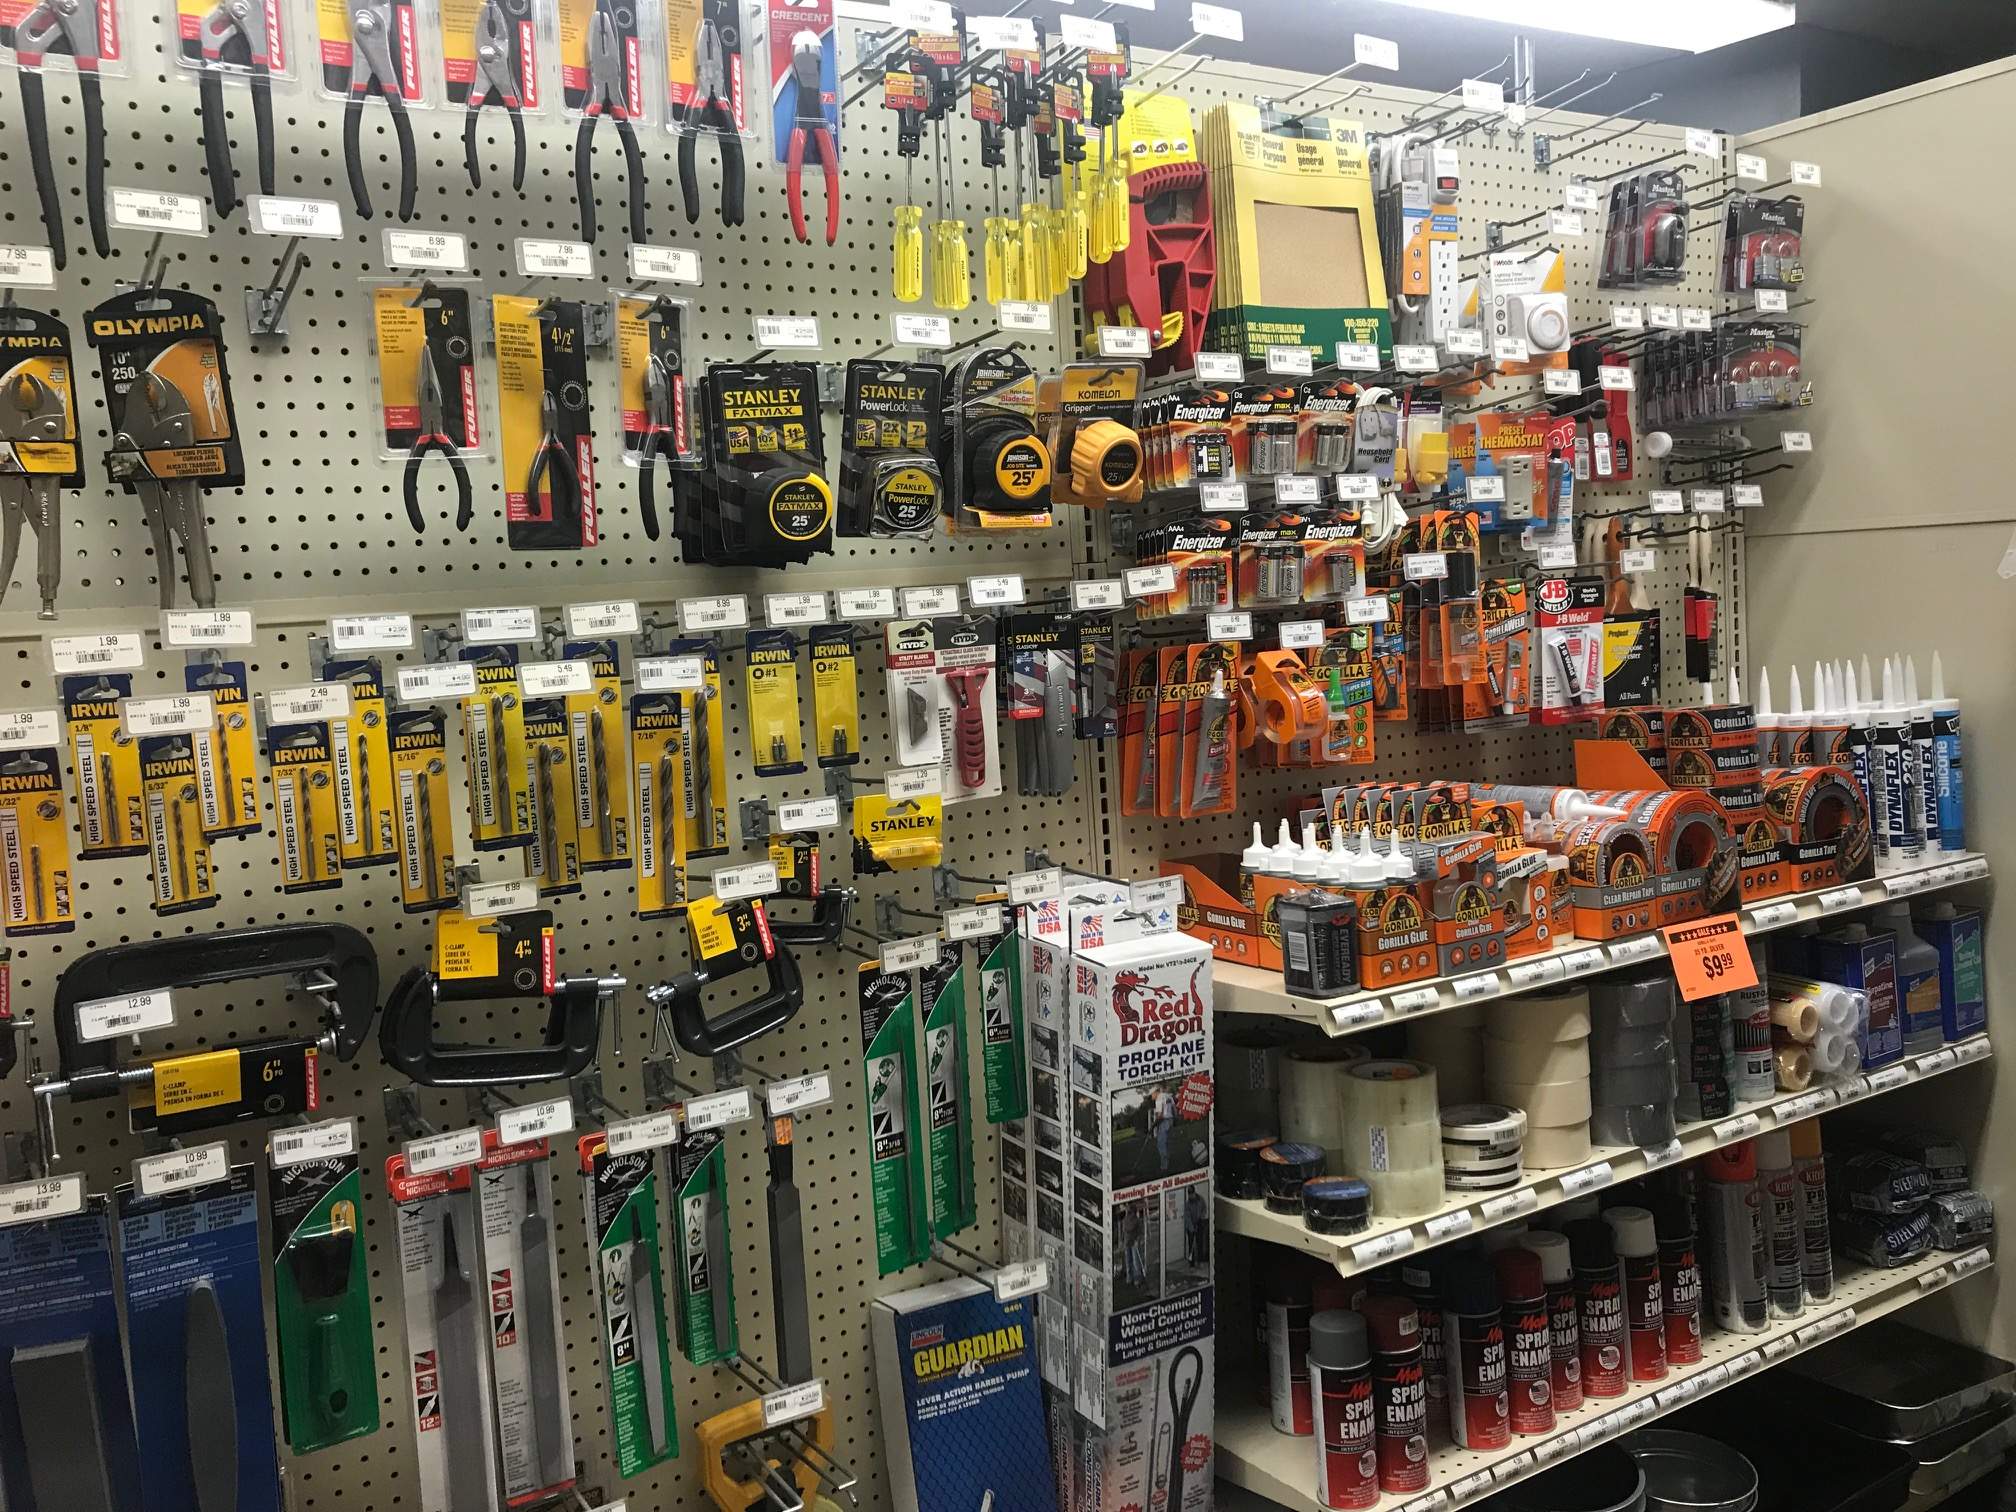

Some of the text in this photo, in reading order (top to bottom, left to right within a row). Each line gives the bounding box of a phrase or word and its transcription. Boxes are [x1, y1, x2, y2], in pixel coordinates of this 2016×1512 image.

[771, 9, 830, 24] CRESCENT
[402, 9, 417, 90] FULLER
[628, 39, 641, 118] FULLER
[732, 56, 744, 130] FULLER
[1336, 128, 1358, 143] 3M
[93, 313, 205, 337] OLYMPIA
[0, 336, 62, 350] YMPIA
[112, 367, 136, 381] 250
[976, 369, 1005, 379] JOHNSON
[724, 389, 801, 406] STANLEY
[860, 385, 927, 400] STANLEY
[1078, 390, 1121, 400] KOMELON
[462, 368, 478, 446] FULLER
[860, 400, 910, 412] PowerLock
[1064, 404, 1092, 414] Gripper
[1233, 401, 1272, 414] Energizer
[1304, 396, 1352, 412] Energizer
[732, 408, 794, 418] FATMAX
[1173, 404, 1226, 422] Energizer
[1499, 426, 1526, 436] PRESET
[730, 439, 749, 449] USA
[1480, 433, 1546, 449] THERMOSTAT
[1357, 447, 1393, 458] Household
[578, 442, 596, 545] FULLER
[895, 482, 928, 492] STANLEY
[778, 502, 823, 511] FATMAX
[888, 493, 929, 505] PowerLock
[1241, 529, 1279, 542] Energizer
[1304, 524, 1357, 539] Energizer
[1173, 533, 1227, 552] Energizer
[1541, 580, 1567, 600] J-B
[1543, 599, 1569, 612] WELD
[213, 613, 231, 623] 1.99
[1569, 612, 1589, 623] Weld
[953, 633, 977, 643] HYDE
[1015, 633, 1059, 644] STANLEY
[1080, 626, 1111, 635] STANLEY
[99, 636, 118, 647] 1.99
[899, 640, 927, 649] HYDE
[751, 648, 790, 663] IRWIN
[815, 643, 850, 657] IRWIN
[765, 667, 778, 678] #1
[827, 661, 839, 672] #2
[1316, 665, 1365, 679] GOILLA
[310, 687, 329, 698] 2.49
[71, 702, 117, 718] IRWI
[13, 713, 33, 725] 1.99
[636, 714, 678, 727] IRWIN
[1713, 716, 1745, 729] GORILLA
[395, 732, 442, 748] IRWIN
[275, 746, 326, 764] IRWIN
[145, 758, 195, 777] IRWIN
[1937, 740, 1950, 798] Silicone
[0, 774, 54, 791] RWIN
[577, 736, 591, 820] HIGH SPEED STEEL
[82, 755, 100, 842] HIGH SPEED STEEL
[338, 746, 354, 836] HIGH SPEED STEEL
[1885, 750, 1903, 833] DYNAFLEX
[642, 786, 652, 870] HIGH SPEED STEEL
[870, 816, 936, 833] STANLEY
[1424, 821, 1467, 840] GORILLA
[404, 794, 419, 881] HIGH SPEED STEEL
[1741, 850, 1781, 868] GORILLA TAPE
[1800, 844, 1837, 859] GORILLA TAPE
[1497, 854, 1537, 881] GORILLA GLUE
[1614, 876, 1643, 889] GORILLA
[1661, 880, 1687, 892] GORILLA
[1604, 886, 1655, 905] CLEAR REPAIR TAPE
[1207, 911, 1246, 930] GORILLA GLUE
[1456, 908, 1489, 923] GORILLA
[1038, 922, 1062, 934] USA
[1384, 916, 1421, 934] GORILLA
[1080, 937, 1104, 950] USA
[1378, 929, 1430, 951] GORILLA GLUE
[864, 974, 908, 999] NICHOLSON
[127, 996, 152, 1009] 12.99
[1142, 993, 1189, 1024] Red
[1120, 1016, 1204, 1047] Dragon
[1118, 1037, 1205, 1068] PROPANE
[1118, 1052, 1206, 1081] TORCH KIT
[307, 1058, 316, 1108] FULLER
[535, 1104, 556, 1117] 10.99
[184, 1150, 209, 1163] 10.99
[486, 1149, 527, 1165] NICHOLSON
[598, 1152, 648, 1185] NICHOLSON
[36, 1182, 62, 1194] 13.99
[1113, 1186, 1146, 1202] Flaming
[1147, 1182, 1161, 1193] For
[1162, 1179, 1173, 1190] All
[1121, 1292, 1202, 1327] Non-Chemical
[1121, 1306, 1203, 1339] Weed Control
[1580, 1315, 1623, 1332] ENAME
[1115, 1341, 1134, 1353] Plus
[1135, 1327, 1174, 1345] Hundreds
[1184, 1316, 1208, 1332] Other
[914, 1325, 1024, 1377] GUARDIAN
[1123, 1348, 1147, 1360] Large
[1156, 1335, 1178, 1350] Small
[916, 1393, 941, 1407] LEVER
[944, 1384, 973, 1400] ACTION
[974, 1376, 1005, 1391] BARREL
[1006, 1368, 1030, 1382] PUMP
